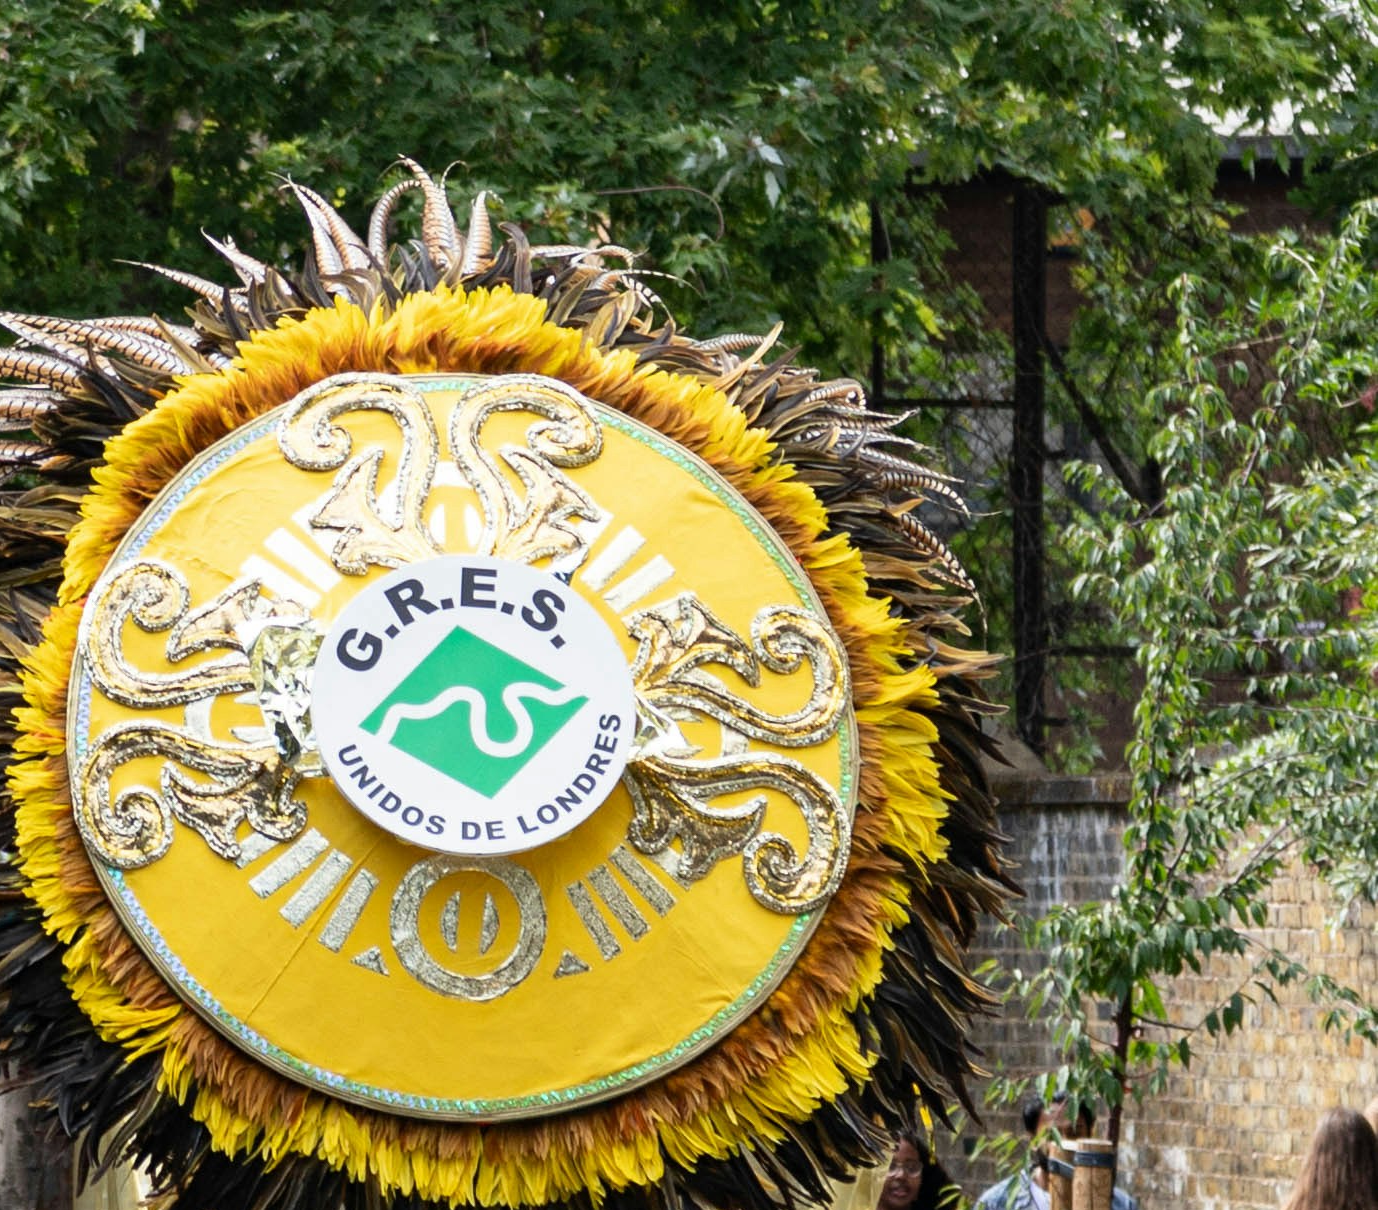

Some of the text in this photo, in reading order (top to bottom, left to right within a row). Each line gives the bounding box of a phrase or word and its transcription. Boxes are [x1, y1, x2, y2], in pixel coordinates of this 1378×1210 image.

[336, 567, 566, 671] G.R.E.S.
[338, 713, 621, 840] UNIDOS DE LONDRES
